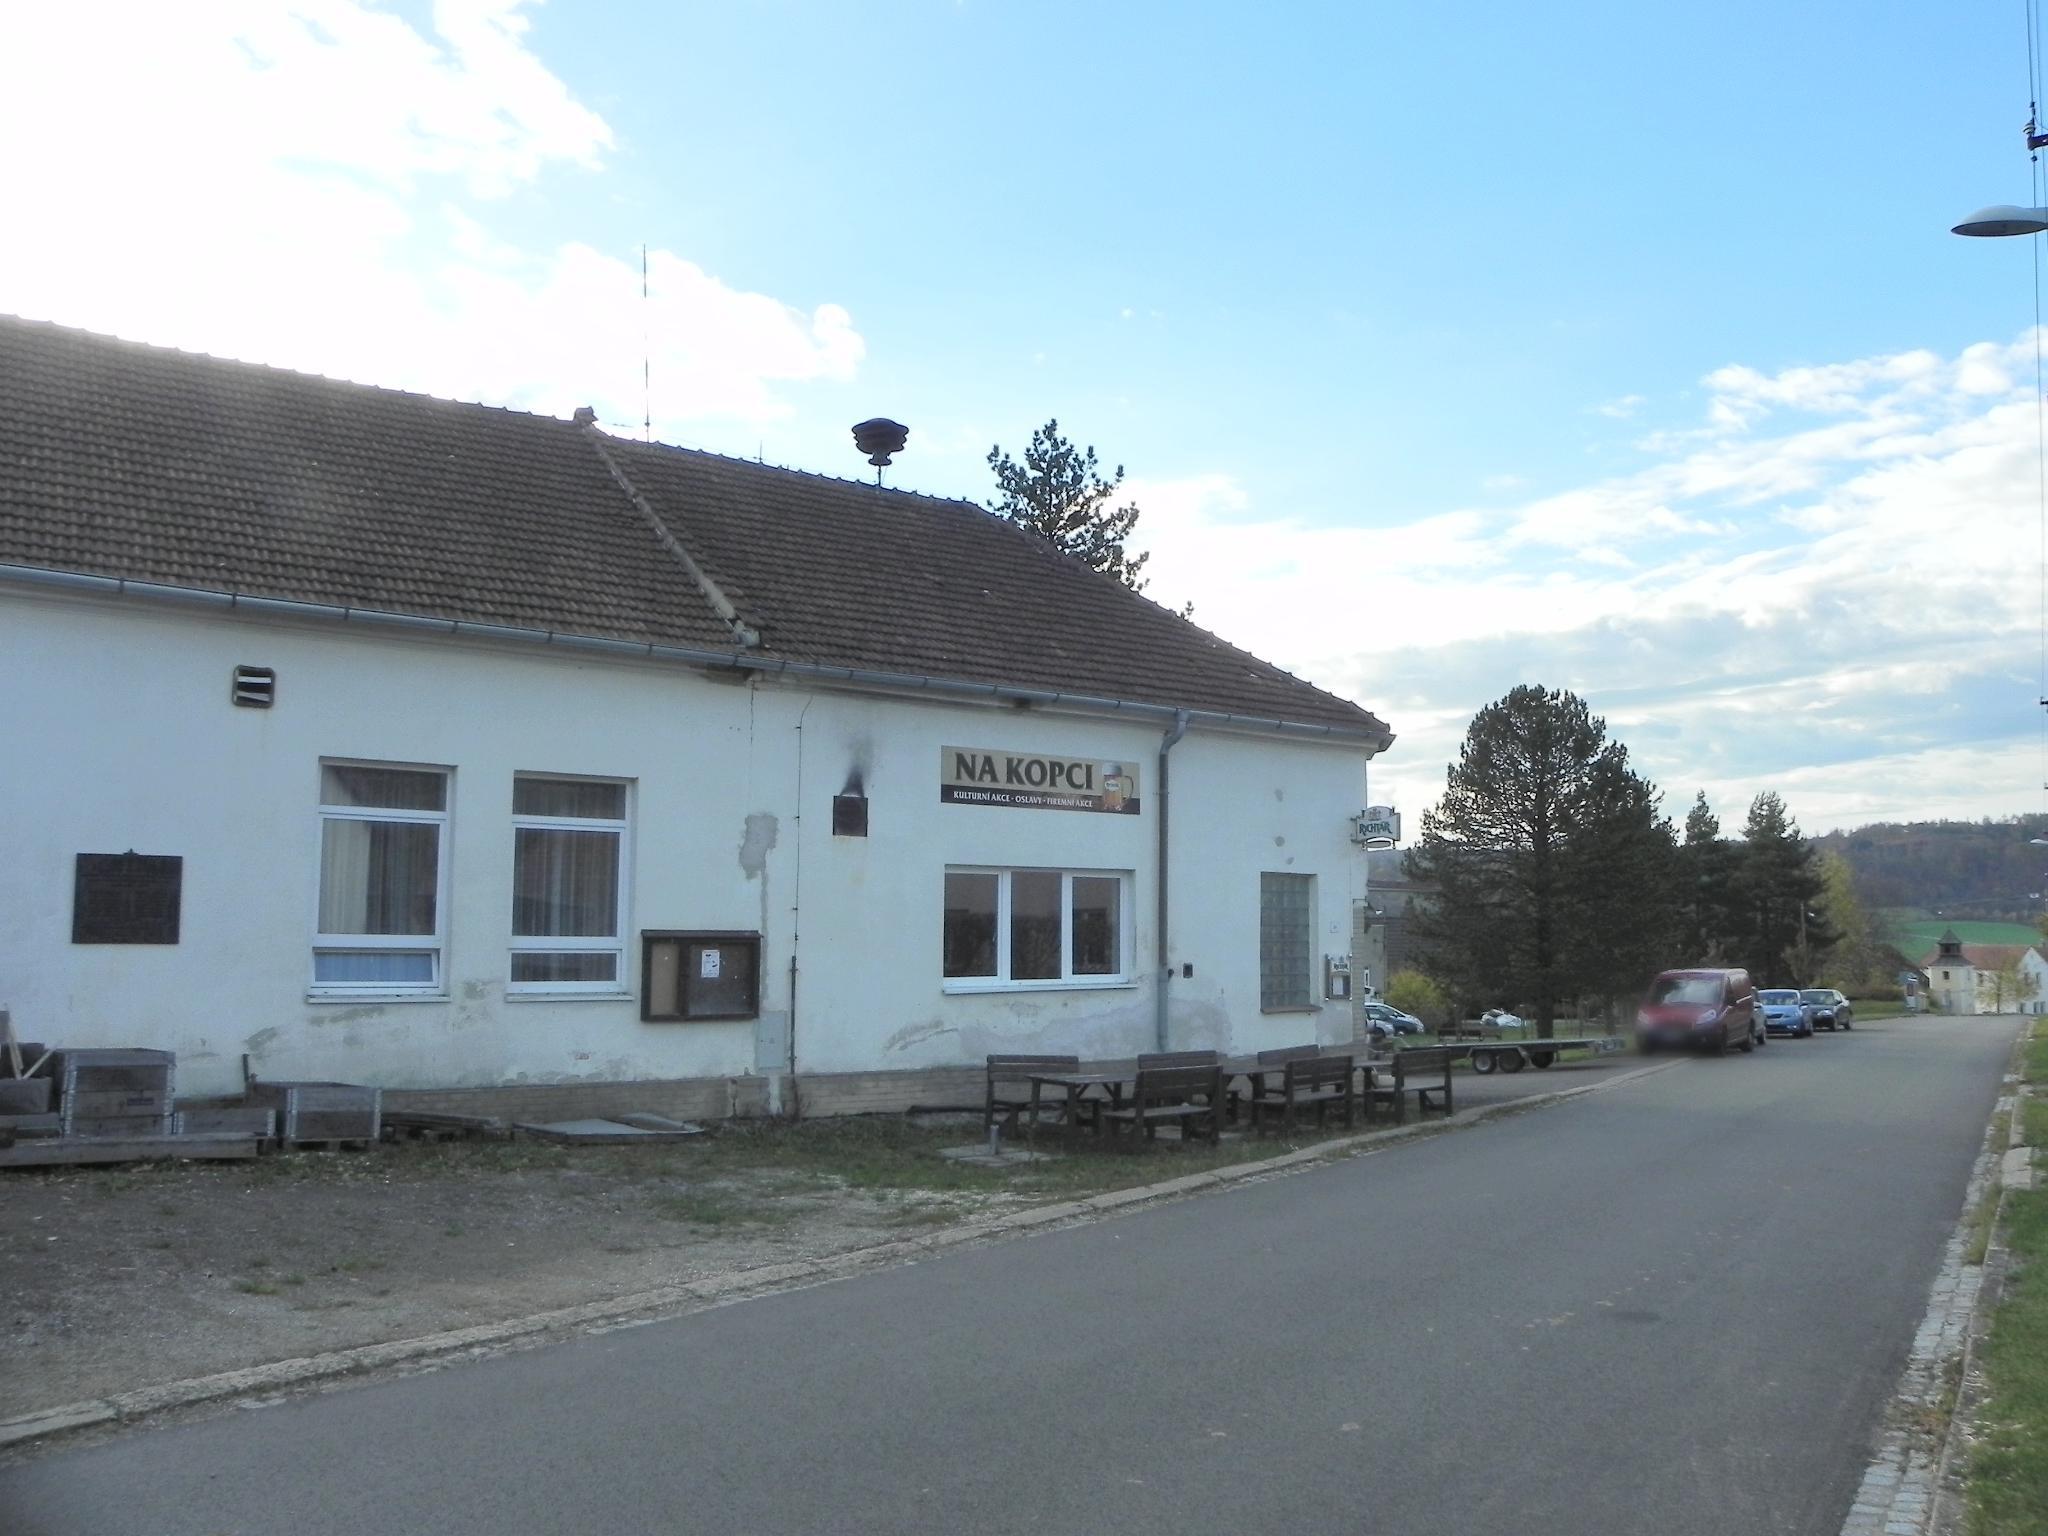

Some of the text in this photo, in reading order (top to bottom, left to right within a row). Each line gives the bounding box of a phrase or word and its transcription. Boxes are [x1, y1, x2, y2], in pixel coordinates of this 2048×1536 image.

[955, 752, 1093, 790] NA KOPCI
[953, 790, 990, 801] KULTURNÍ
[991, 793, 1010, 803] AKCE
[1015, 795, 1042, 805] OSLAVY
[1076, 799, 1093, 808] AKCE
